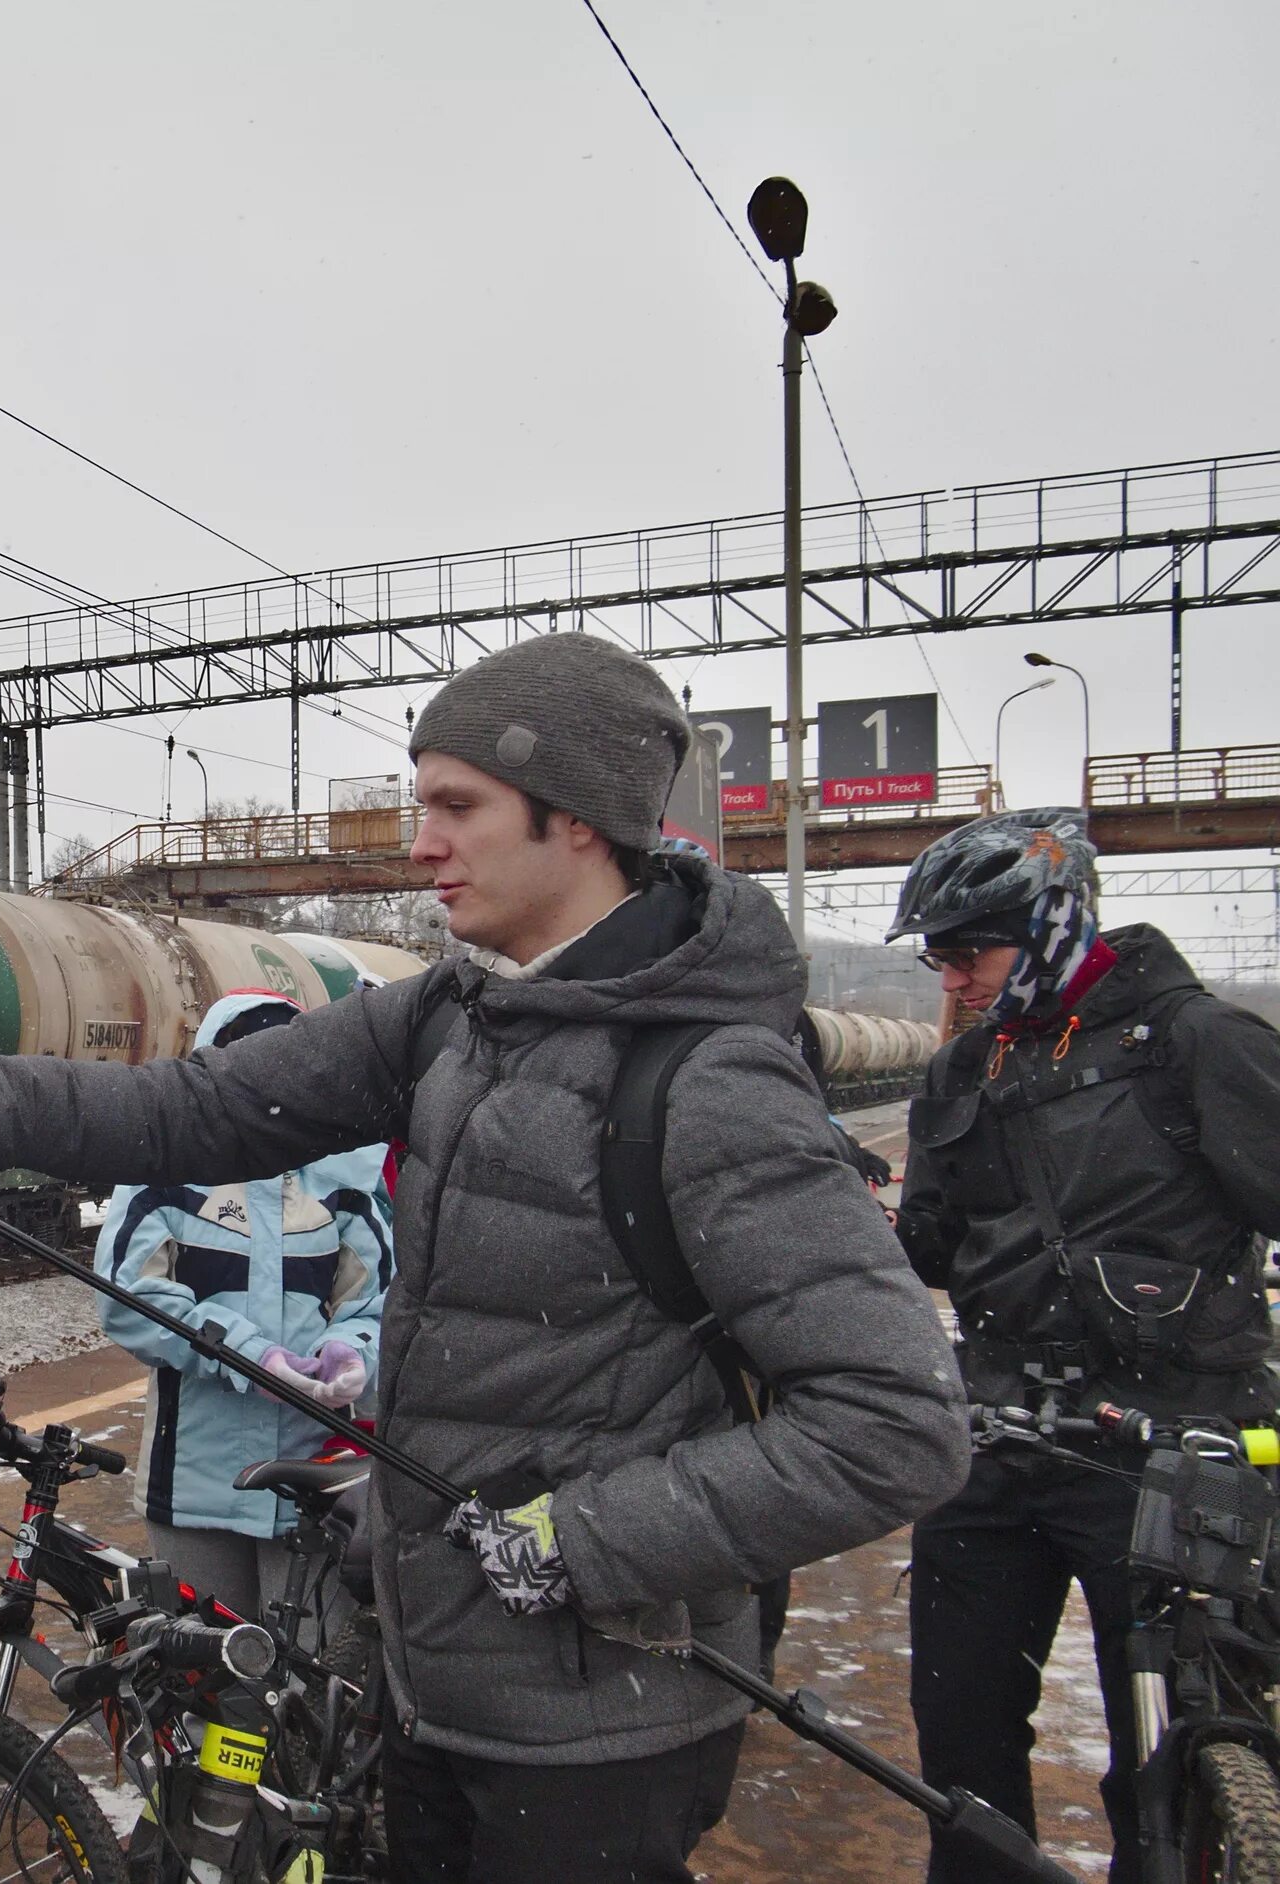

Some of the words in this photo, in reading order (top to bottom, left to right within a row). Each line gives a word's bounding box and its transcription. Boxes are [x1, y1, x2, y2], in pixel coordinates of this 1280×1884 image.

[697, 721, 735, 780] 2
[861, 708, 889, 770] 1
[723, 792, 756, 805] Track
[834, 781, 874, 800] Путь
[887, 780, 923, 794] Track
[85, 1023, 138, 1047] 51841070
